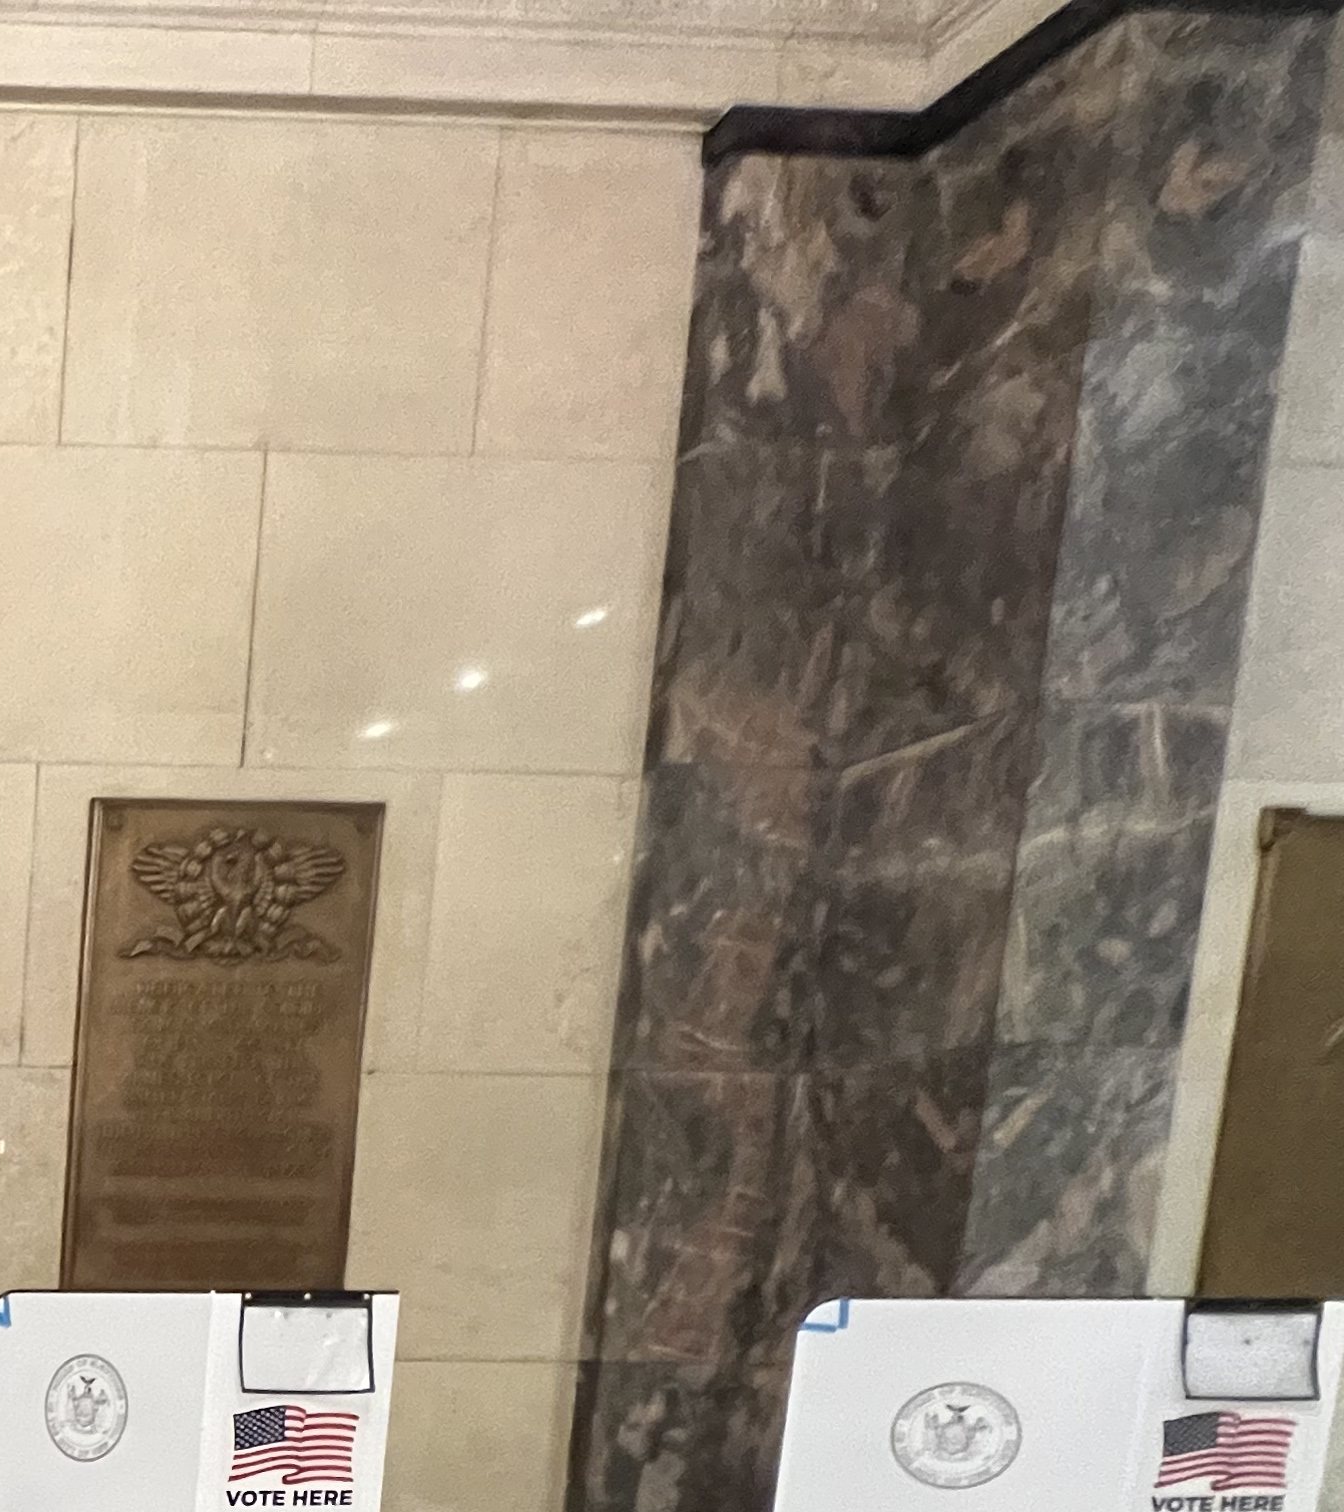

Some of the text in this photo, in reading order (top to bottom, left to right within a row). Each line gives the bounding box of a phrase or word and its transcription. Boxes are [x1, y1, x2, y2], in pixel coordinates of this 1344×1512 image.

[226, 1489, 354, 1507] VOTE HERE
[1151, 1494, 1286, 1512] VOTE HERE
